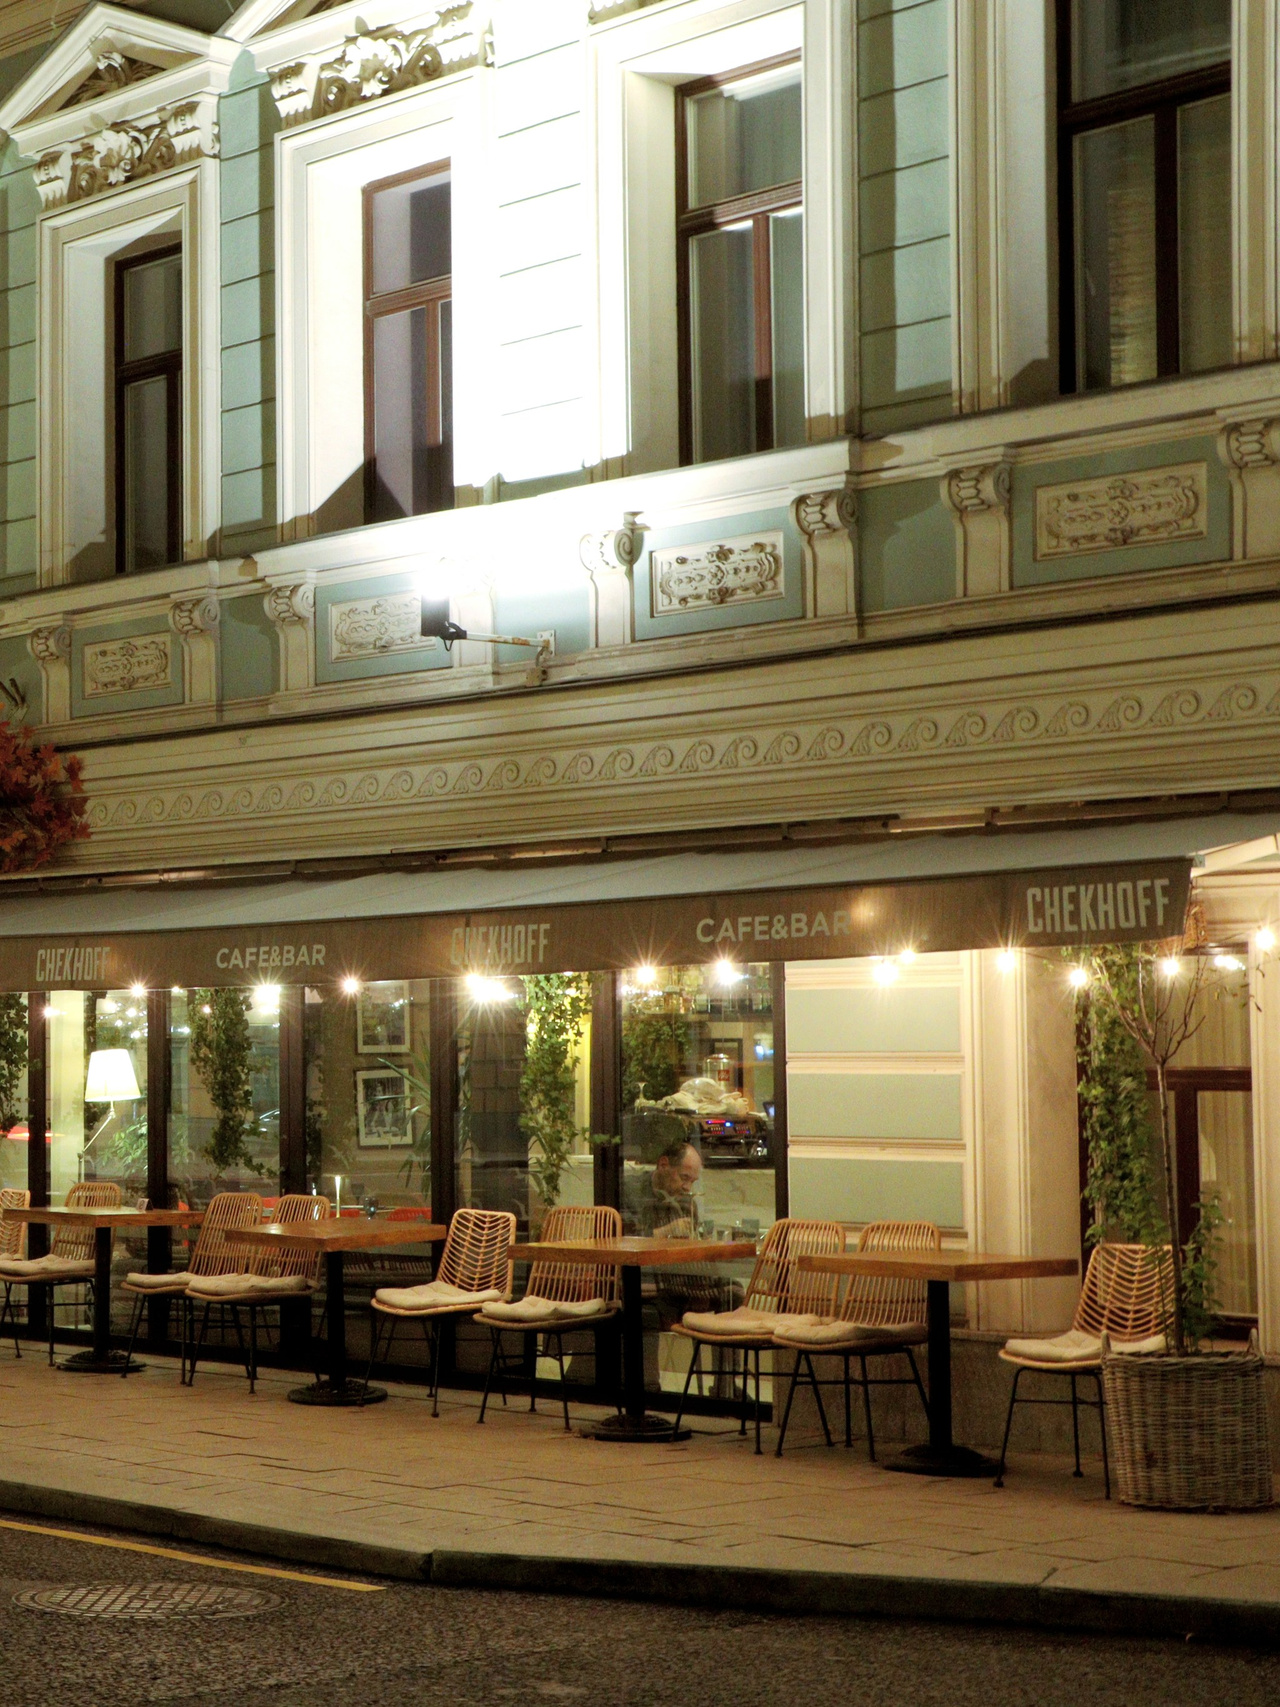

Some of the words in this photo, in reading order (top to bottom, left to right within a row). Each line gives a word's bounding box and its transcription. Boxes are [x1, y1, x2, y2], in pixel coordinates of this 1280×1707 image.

[36, 946, 111, 982] CHEKHOFF
[216, 944, 326, 969] CAFE&BAR
[450, 923, 550, 966] CHEKHOFF
[696, 910, 852, 943] CAFE&BAR
[1026, 878, 1170, 934] CHEKHOFF
